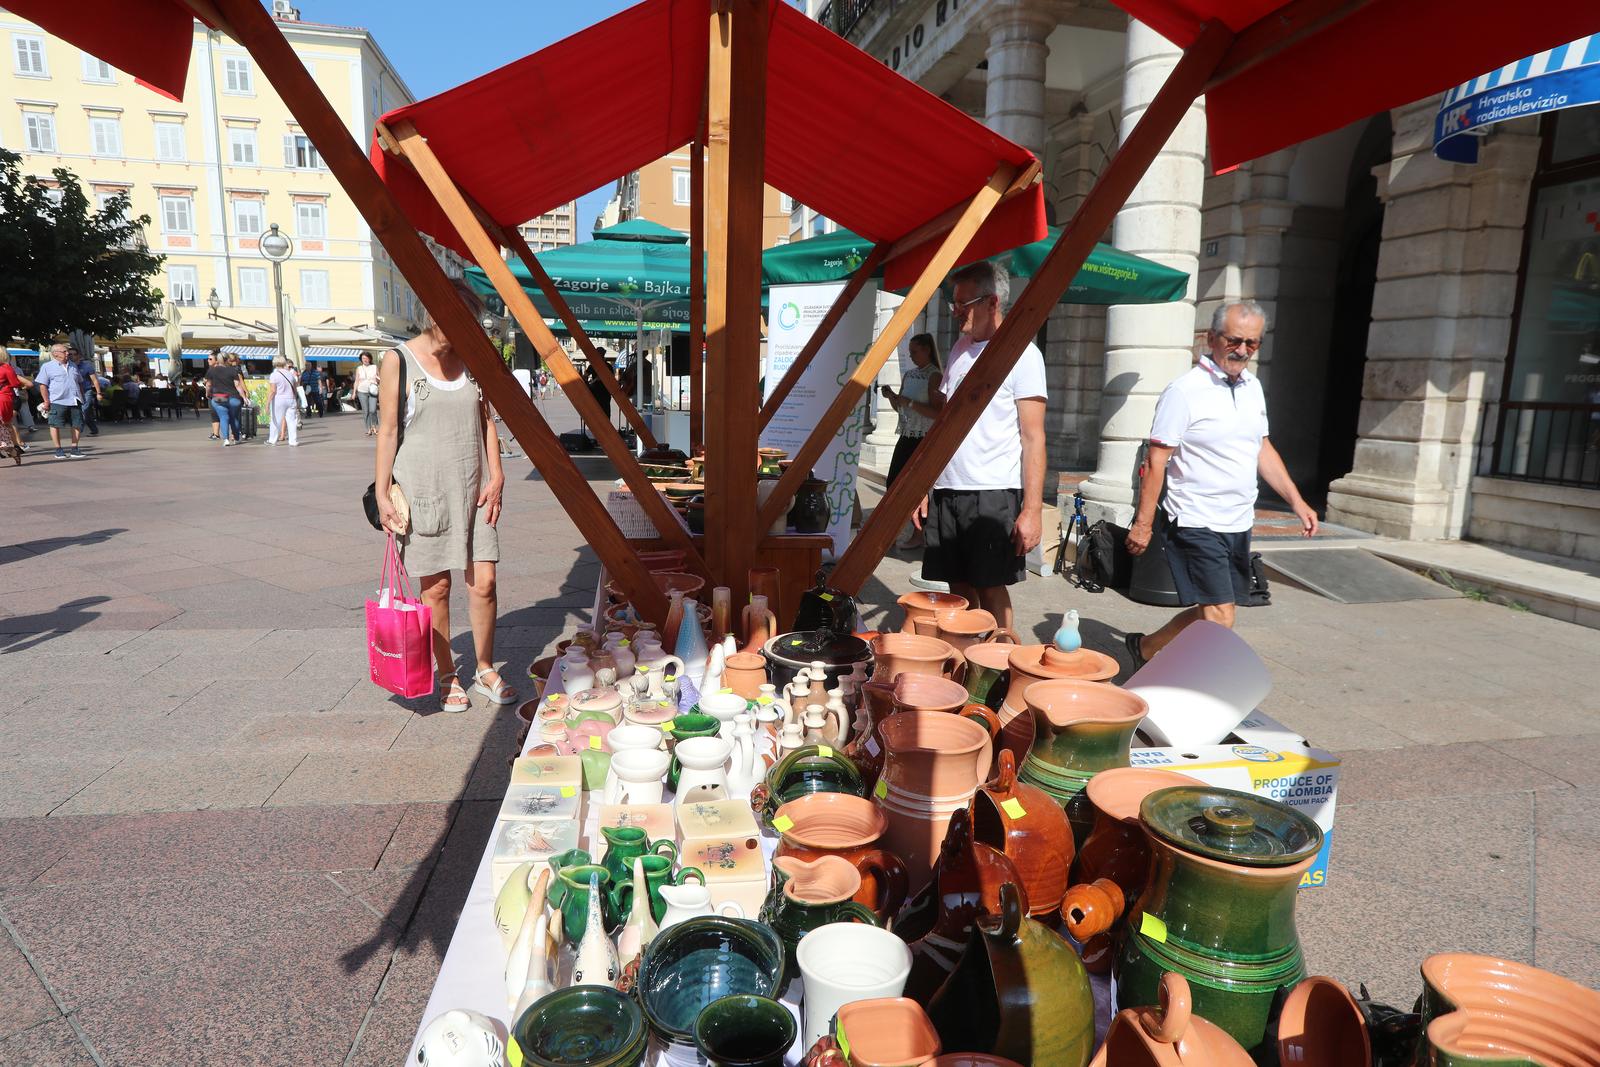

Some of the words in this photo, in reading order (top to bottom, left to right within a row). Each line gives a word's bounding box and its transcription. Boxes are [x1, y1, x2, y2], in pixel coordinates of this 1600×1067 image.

[884, 24, 924, 70] DIO
[1478, 86, 1533, 109] Hrvatska
[1476, 93, 1568, 123] radiotelevizija
[823, 258, 843, 268] Zagorje
[552, 276, 609, 292] Zagorje
[644, 280, 681, 297] Bajka
[604, 318, 681, 329] www.viszagorje.hr
[1253, 775, 1313, 789] PRODUCE
[1315, 774, 1333, 786] OF
[1271, 785, 1333, 798] COLOMBIA
[1311, 797, 1329, 805] PACK
[1298, 869, 1324, 886] AS
